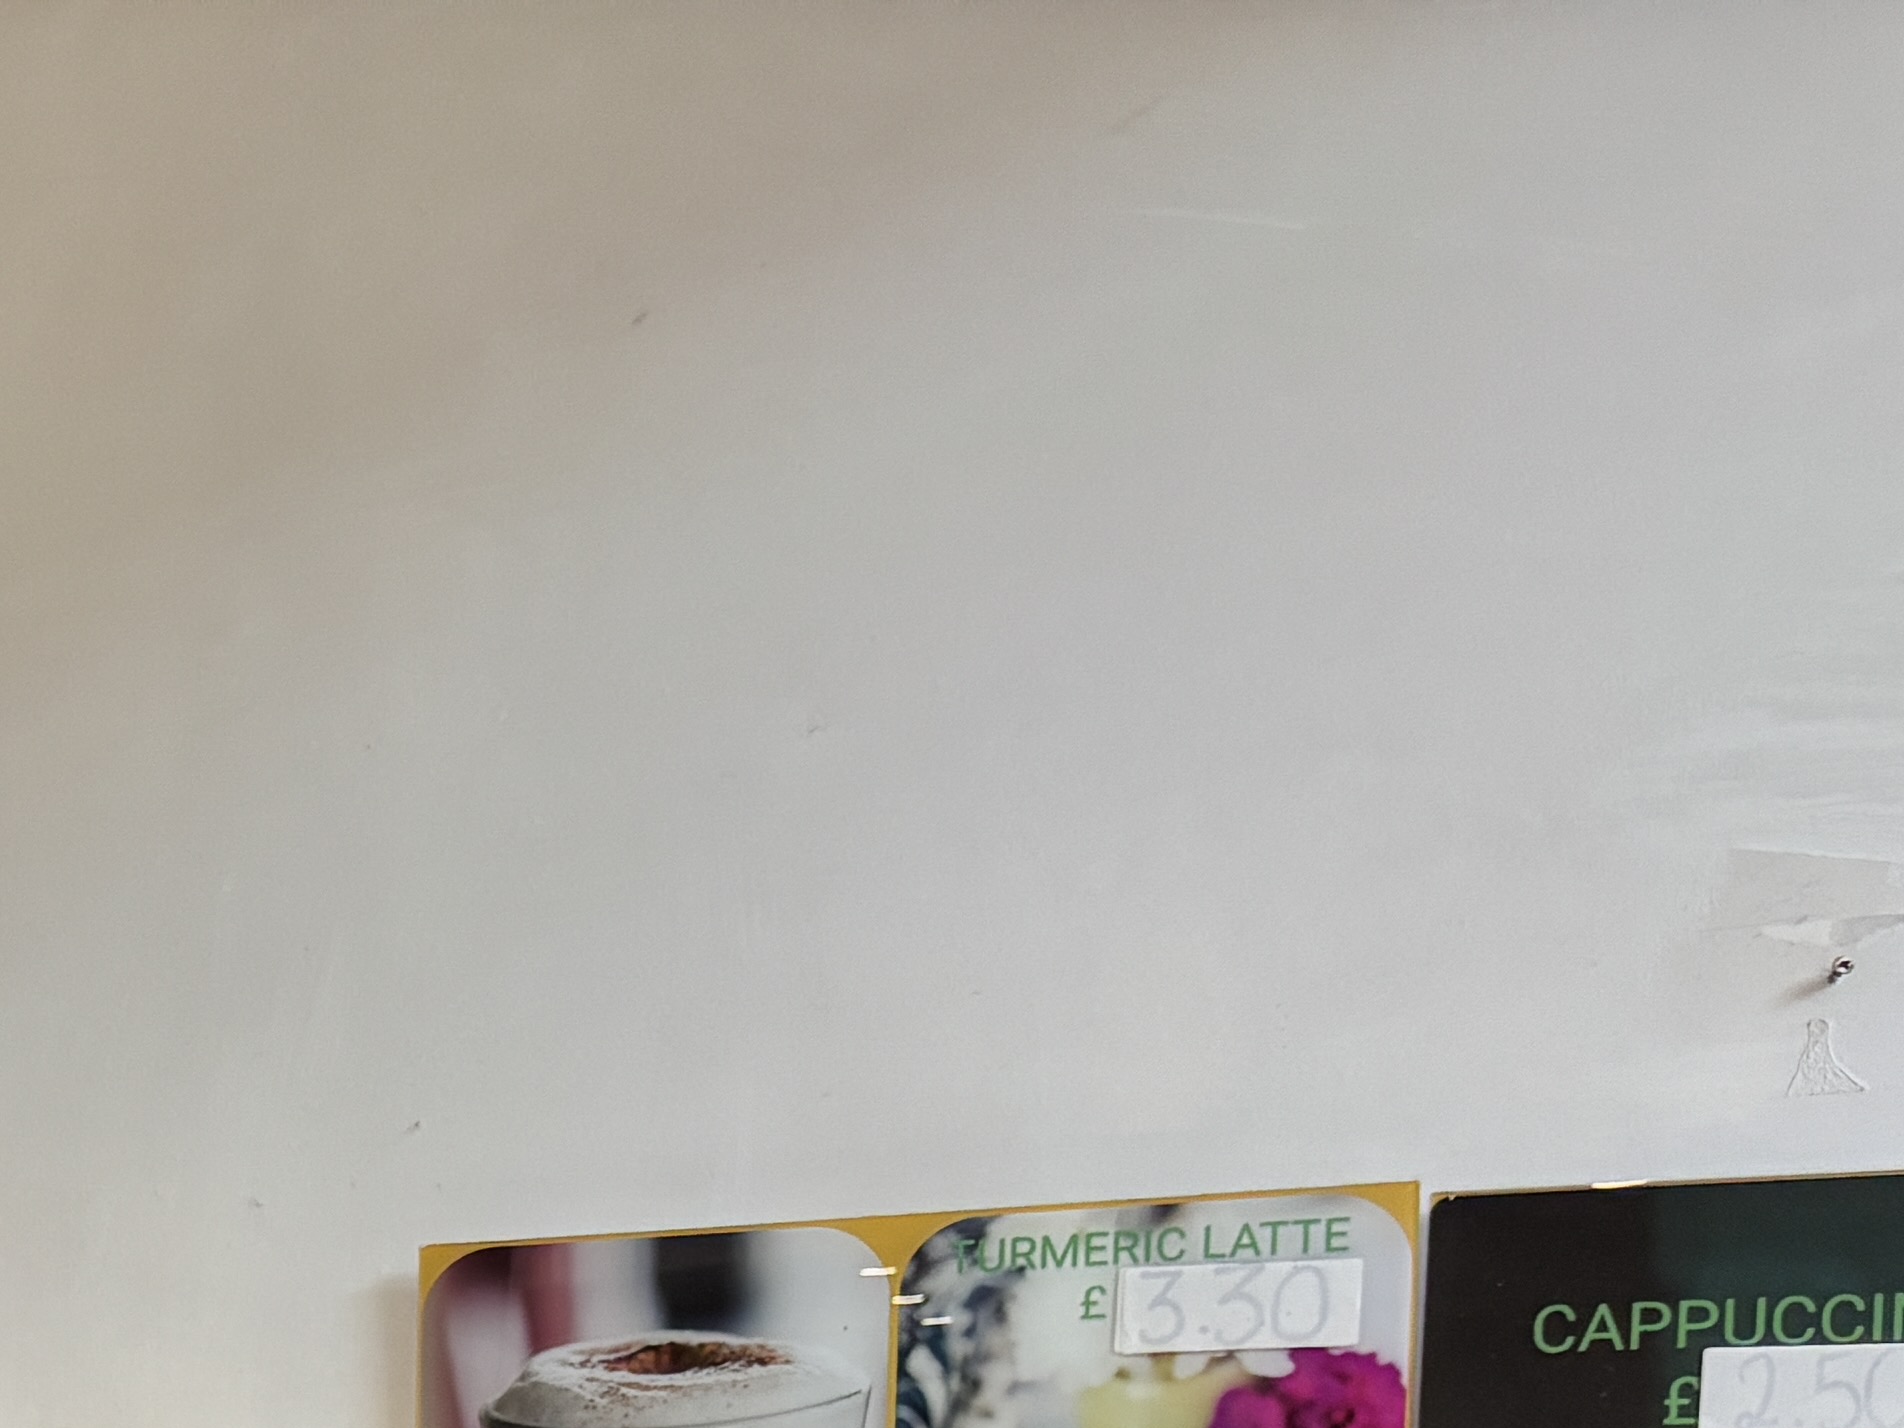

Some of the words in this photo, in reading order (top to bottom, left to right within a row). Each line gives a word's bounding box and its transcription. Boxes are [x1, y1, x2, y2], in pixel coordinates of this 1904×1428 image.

[953, 1227, 1186, 1274] TURMERIC
[1202, 1217, 1351, 1261] LATTE
[1080, 1286, 1107, 1321] £
[1138, 1265, 1331, 1347] 3.30
[1533, 1293, 1904, 1355] CAPPUCCI
